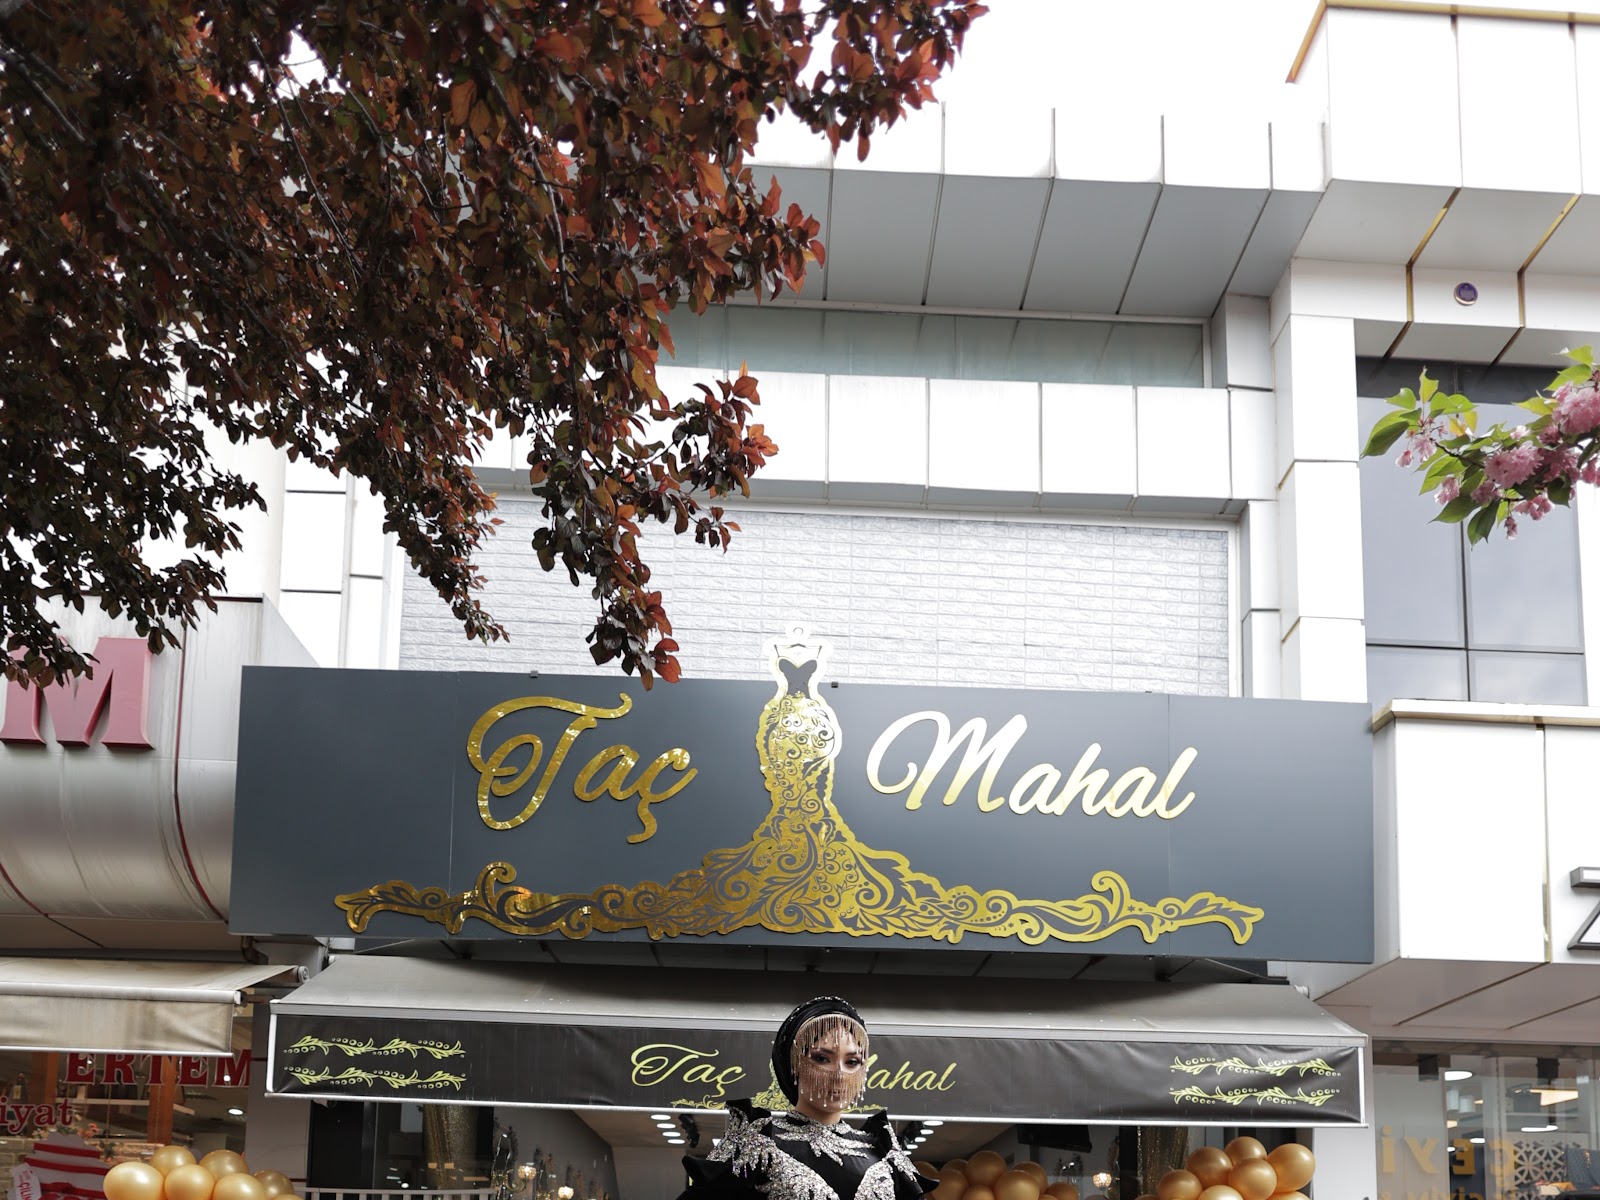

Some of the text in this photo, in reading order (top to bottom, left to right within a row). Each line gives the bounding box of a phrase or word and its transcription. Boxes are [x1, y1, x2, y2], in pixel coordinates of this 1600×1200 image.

[466, 692, 1198, 844] Taç Mahal
[630, 1043, 957, 1098] Taç ahal
[0, 1098, 73, 1134] iyat
